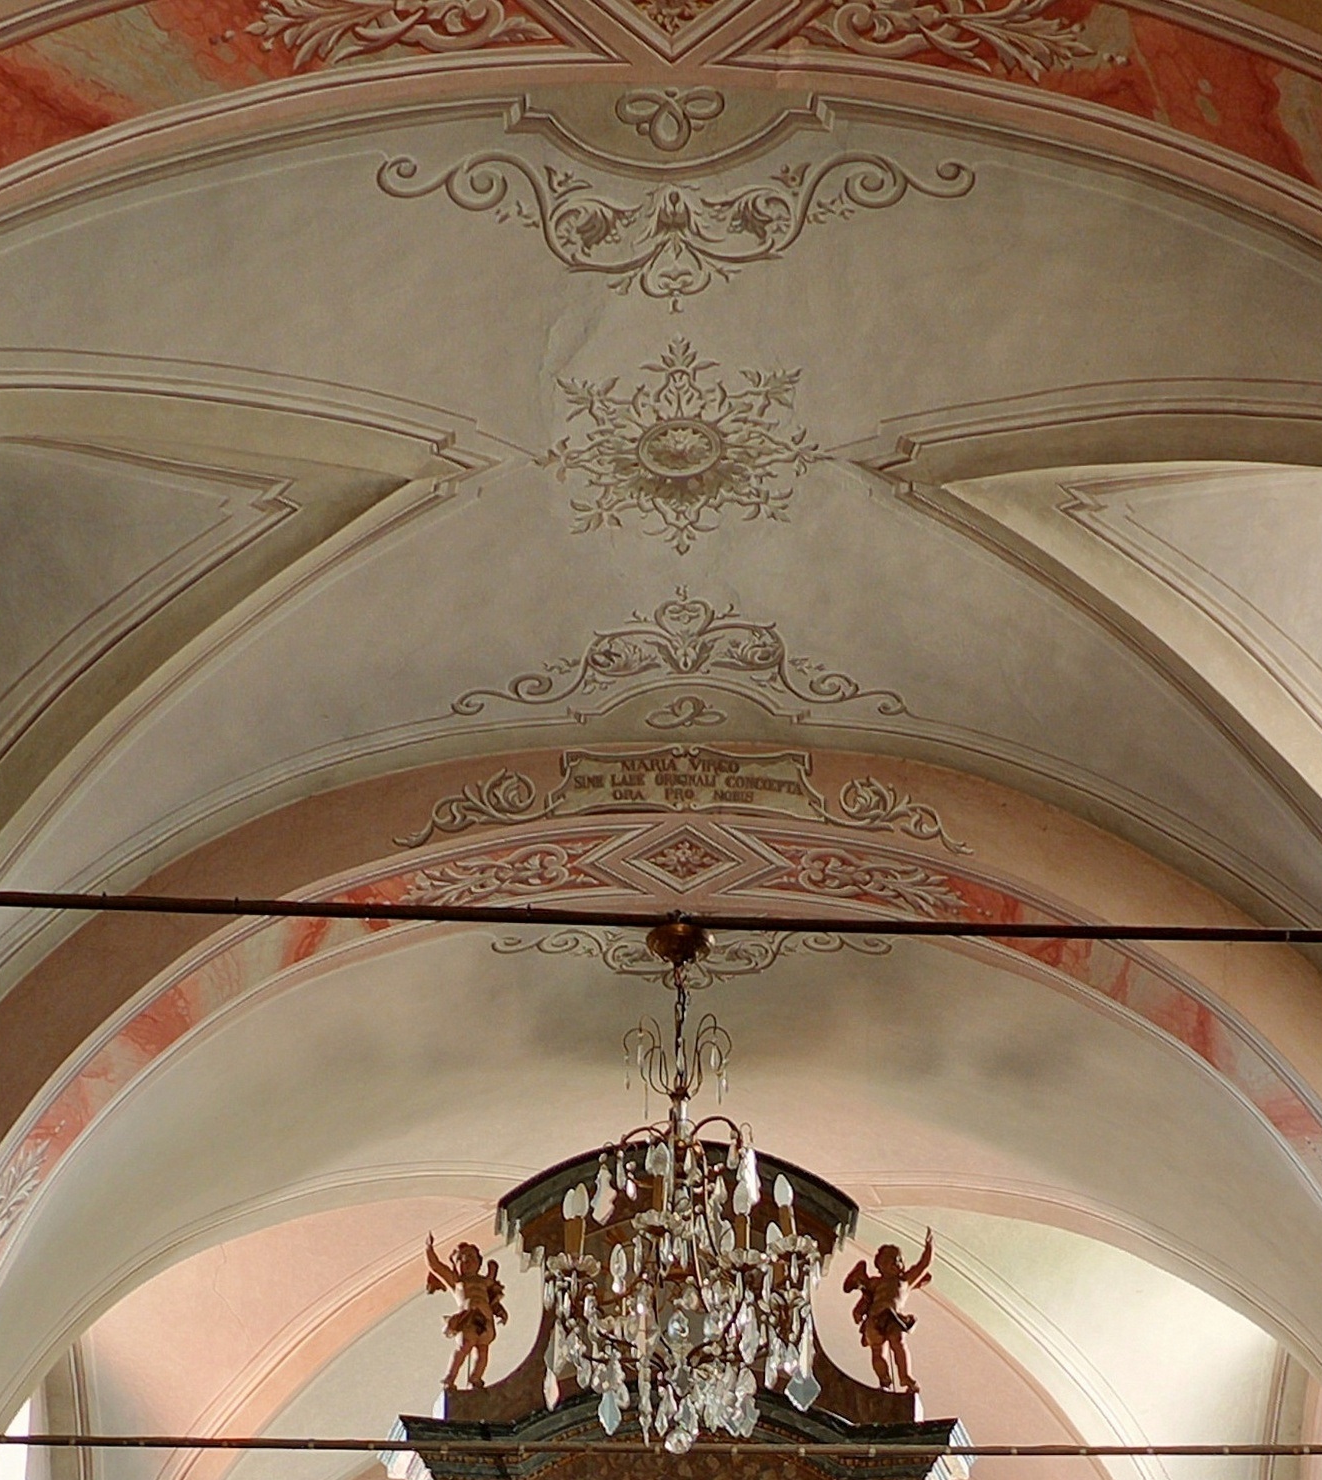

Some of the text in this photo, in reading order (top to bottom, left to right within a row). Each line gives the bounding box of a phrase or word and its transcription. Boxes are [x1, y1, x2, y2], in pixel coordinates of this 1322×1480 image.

[620, 758, 740, 774] MARIA VIRGO
[573, 775, 604, 789] SINE
[612, 788, 754, 804] ORA PRO NOBIS
